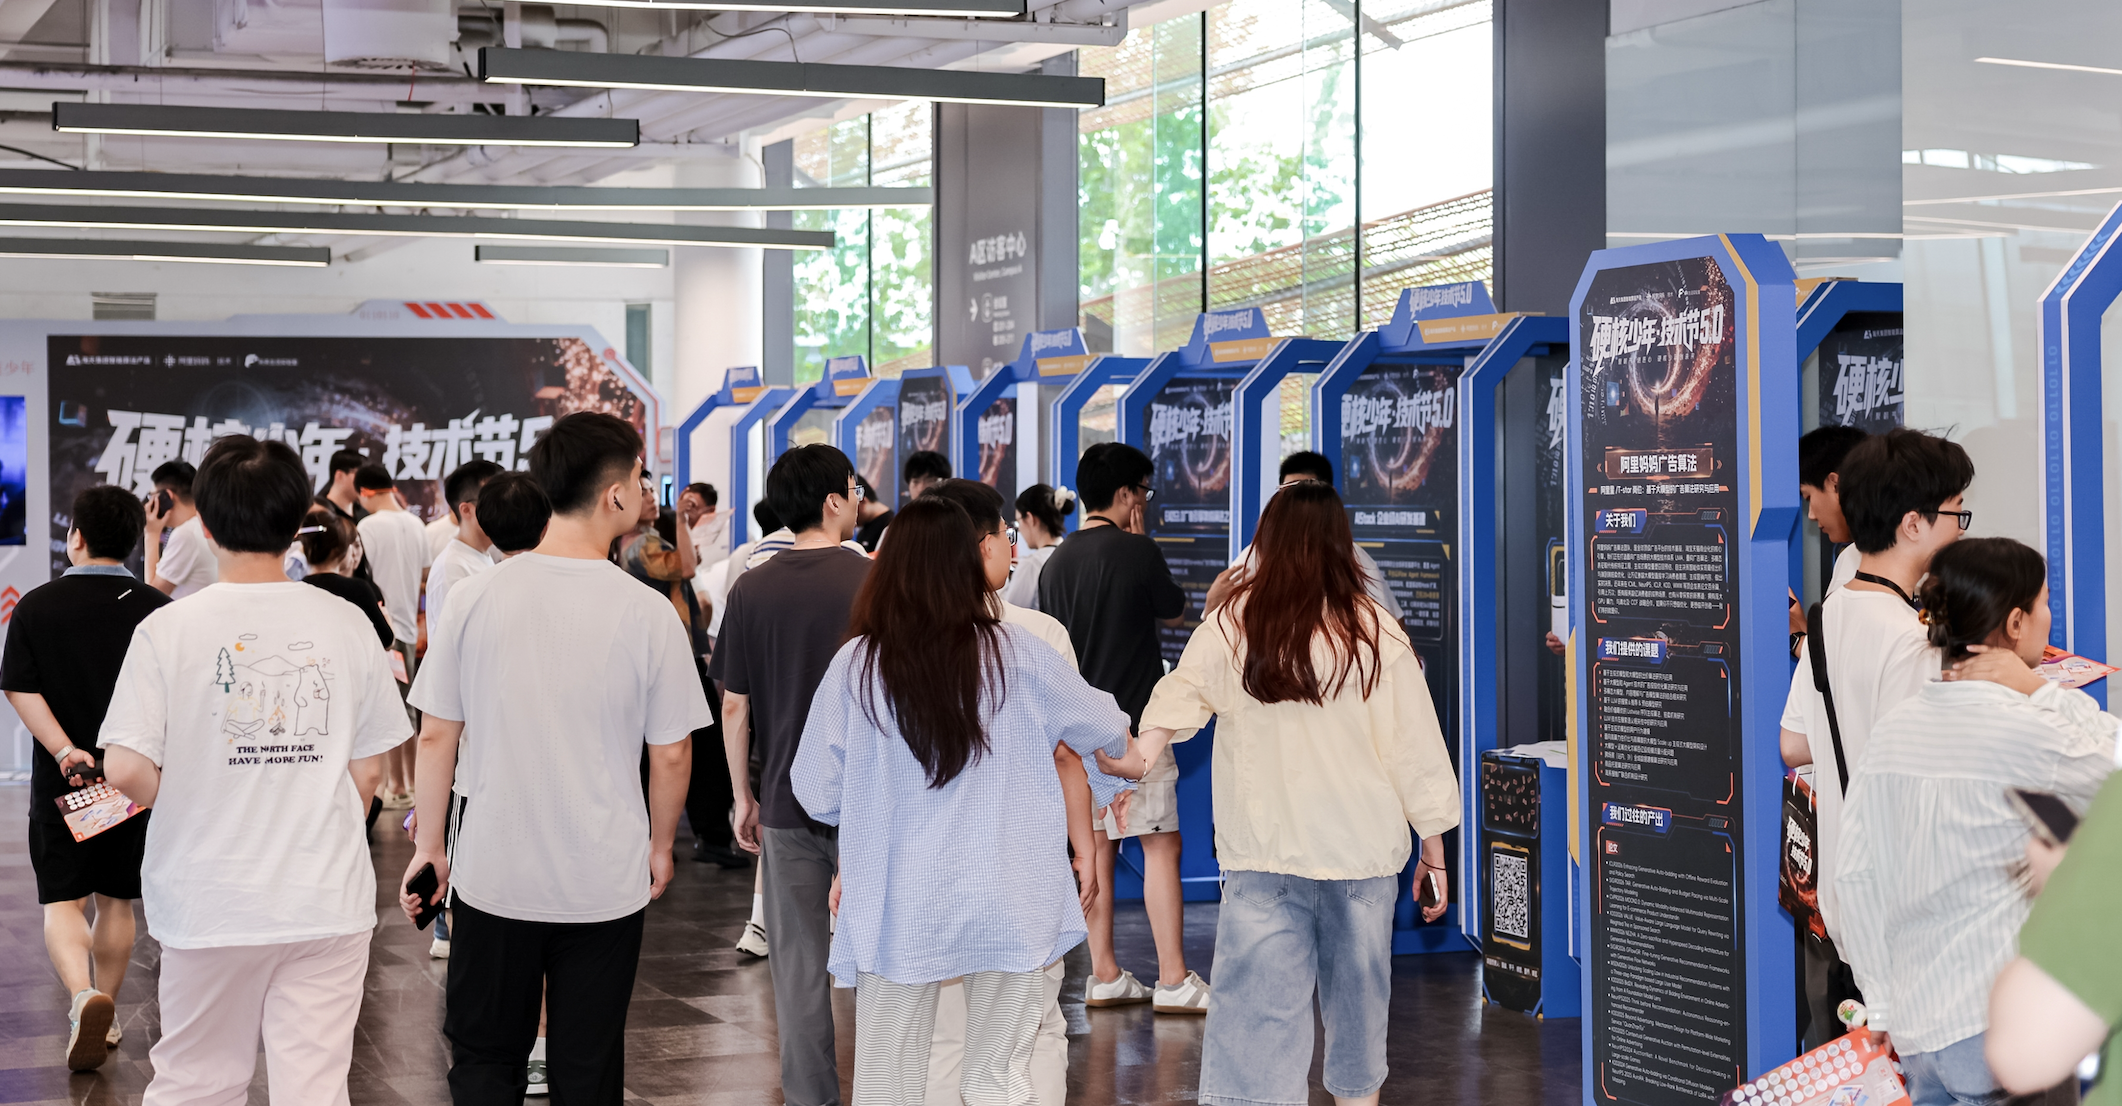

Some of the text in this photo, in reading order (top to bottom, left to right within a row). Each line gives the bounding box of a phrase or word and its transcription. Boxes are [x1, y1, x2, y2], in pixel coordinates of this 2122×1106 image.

[1620, 454, 1697, 473] 阿里妈妈广告算法
[1605, 513, 1636, 528] 关于我们
[1605, 640, 1659, 657] 我们提供的课题
[236, 746, 257, 754] THE
[291, 744, 315, 752] FACE
[228, 757, 261, 766] HAVE
[298, 754, 323, 763] FUN!
[1609, 805, 1663, 827] 我们过往的产出
